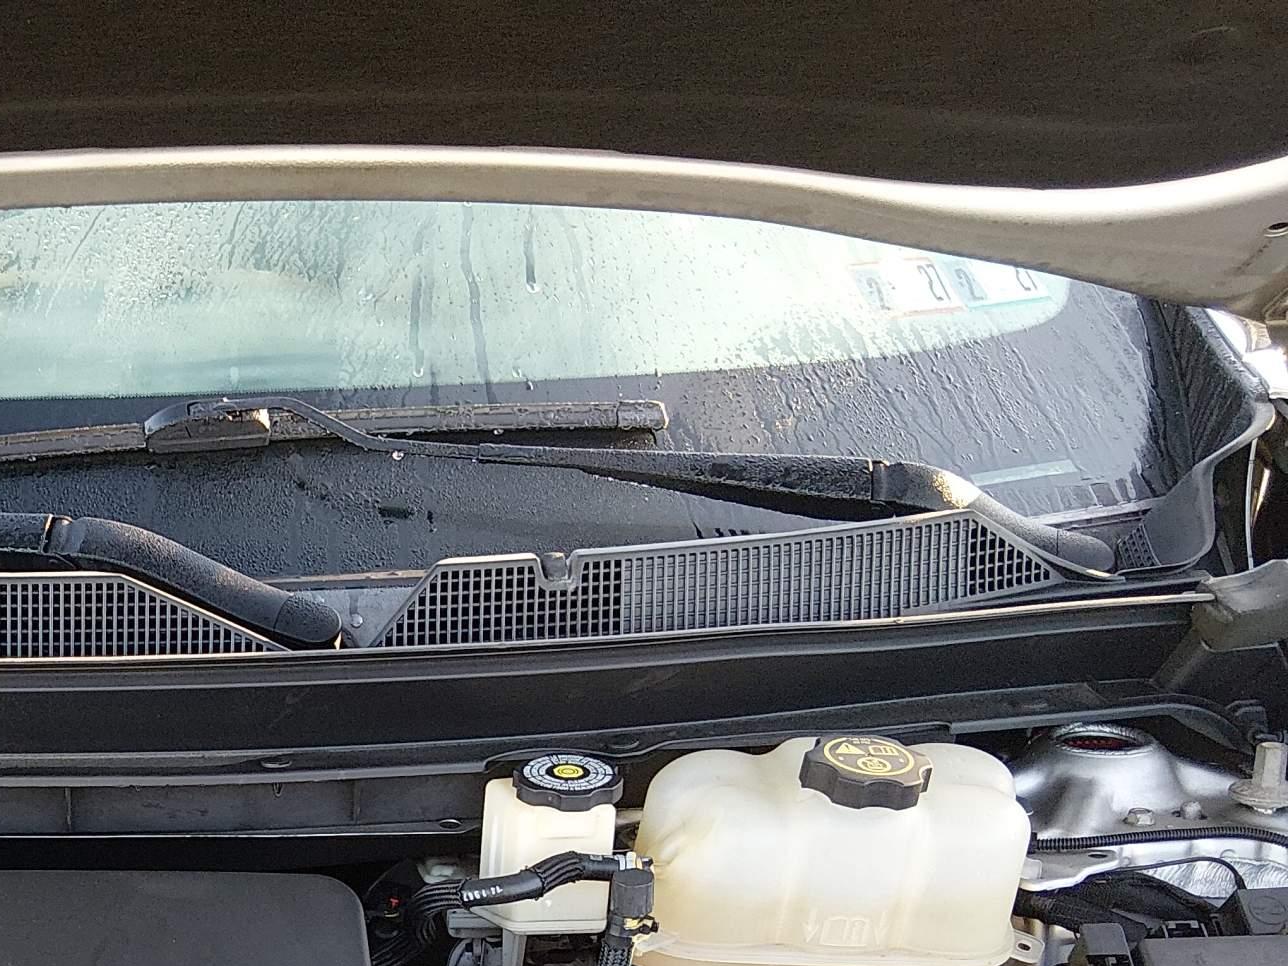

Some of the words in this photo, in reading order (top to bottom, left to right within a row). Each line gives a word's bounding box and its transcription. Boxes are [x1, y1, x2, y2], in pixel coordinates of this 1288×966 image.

[917, 264, 952, 302] 27
[954, 268, 985, 301] 2
[1014, 267, 1039, 292] 2
